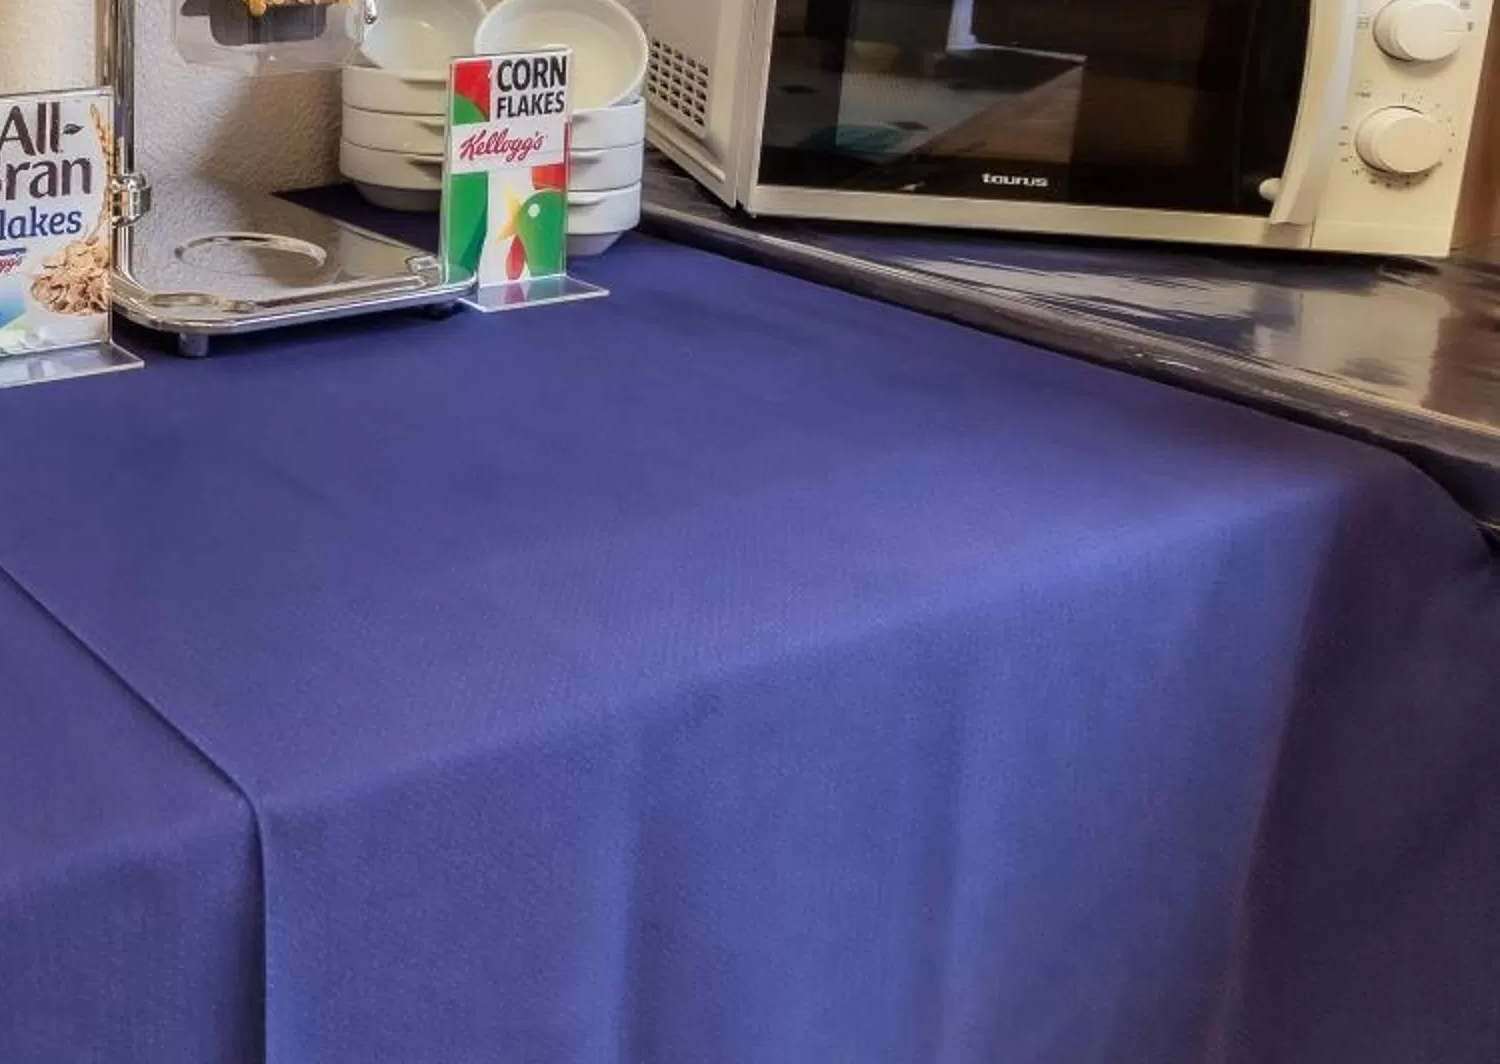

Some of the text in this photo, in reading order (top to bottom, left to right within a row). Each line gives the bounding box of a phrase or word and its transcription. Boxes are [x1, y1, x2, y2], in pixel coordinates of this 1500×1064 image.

[497, 55, 567, 92] CORN
[497, 91, 565, 119] FLAKES
[459, 127, 544, 162] Kellogg's
[981, 172, 1049, 188] taurus
